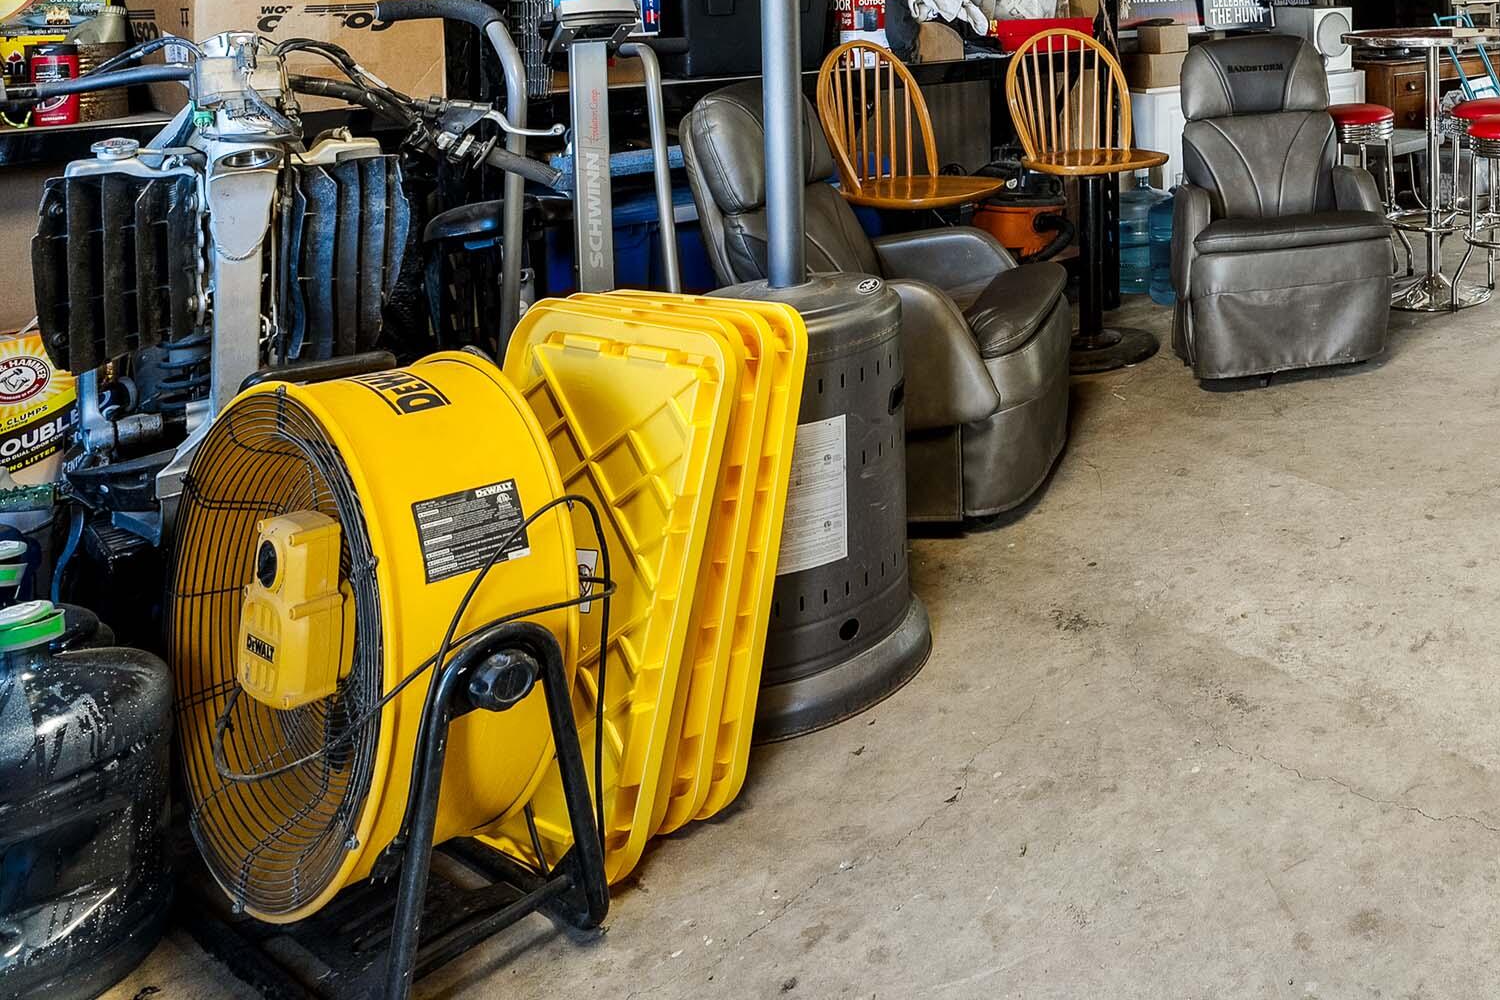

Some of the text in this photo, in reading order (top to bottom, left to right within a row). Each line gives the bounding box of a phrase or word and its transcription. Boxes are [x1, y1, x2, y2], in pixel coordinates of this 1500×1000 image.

[1210, 7, 1264, 24] THE HUNT
[586, 152, 604, 269] SCHWINN
[8, 358, 47, 380] HAMMER
[6, 404, 48, 426] CLUMPS
[0, 409, 79, 457] OUBLE
[25, 446, 56, 466] LITTER
